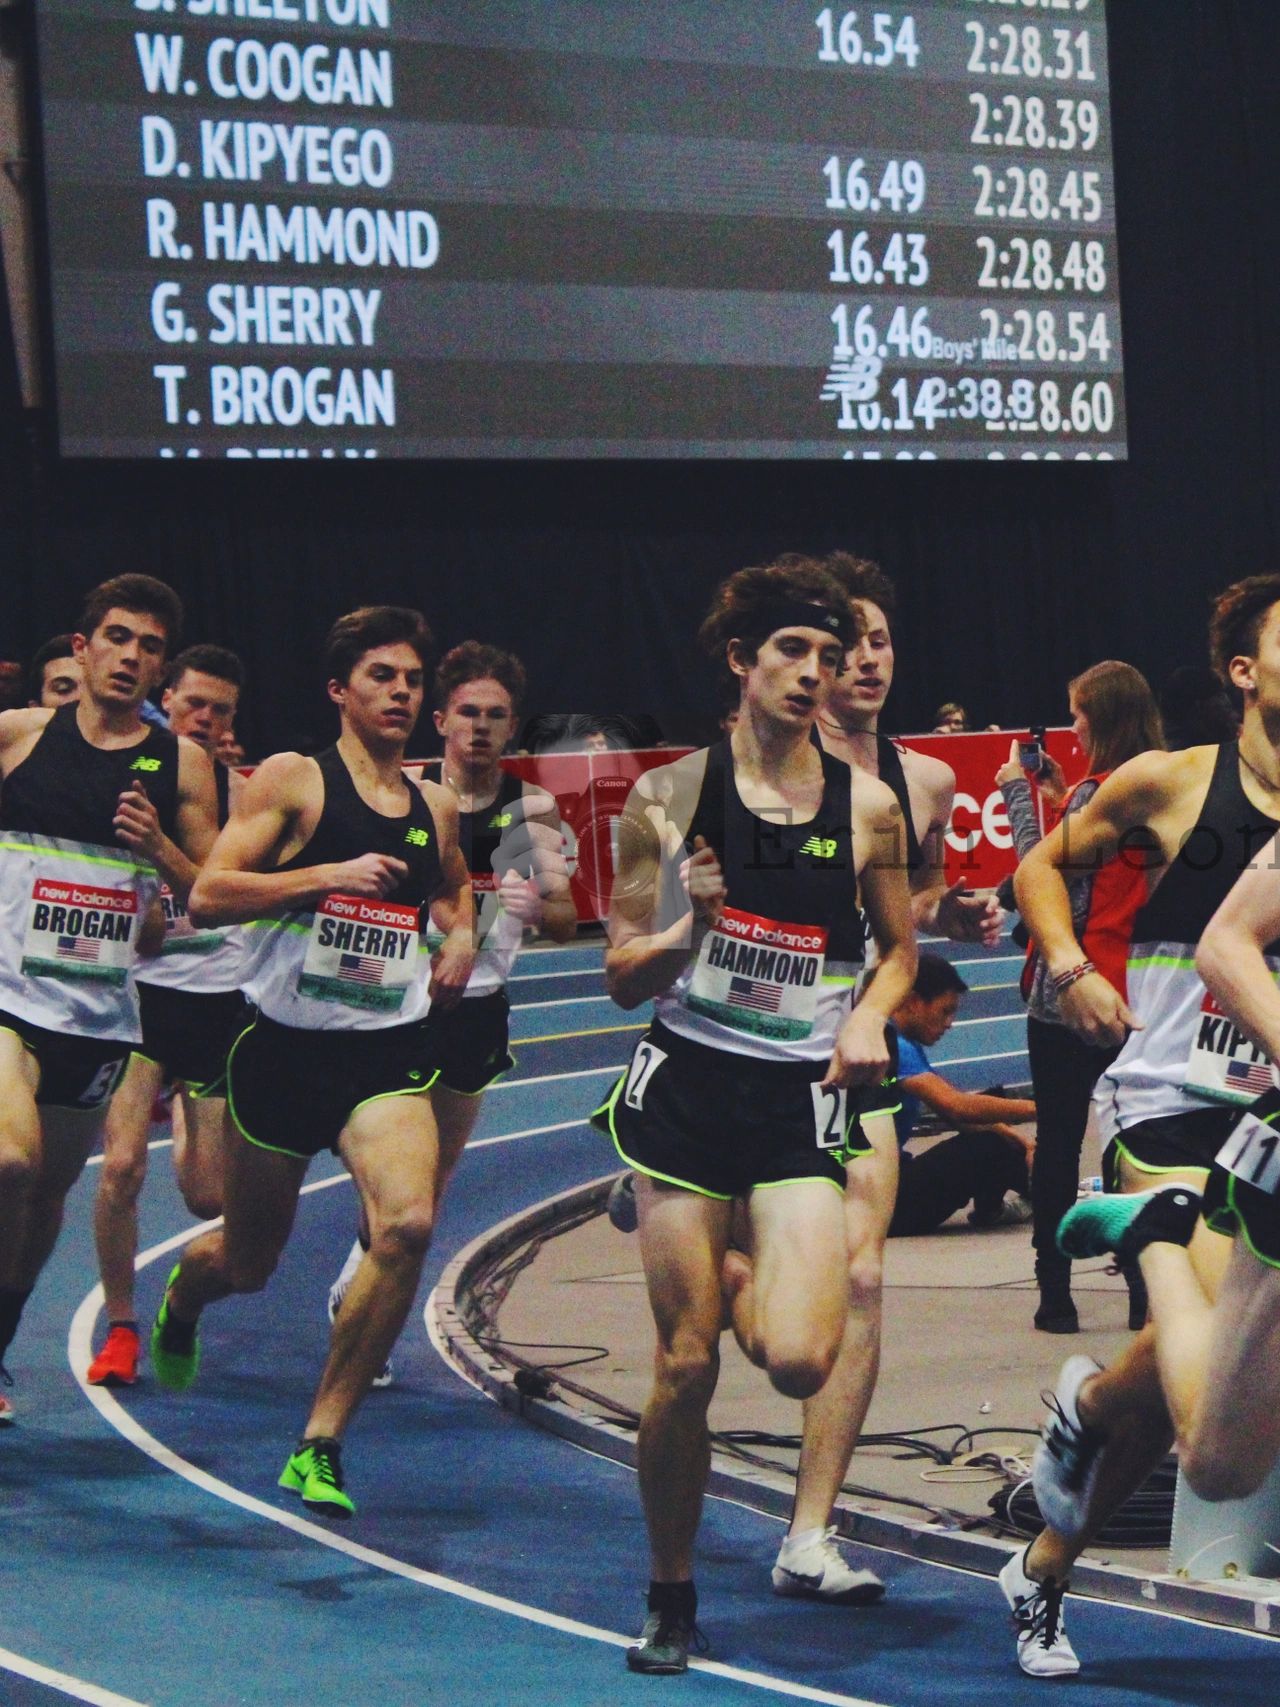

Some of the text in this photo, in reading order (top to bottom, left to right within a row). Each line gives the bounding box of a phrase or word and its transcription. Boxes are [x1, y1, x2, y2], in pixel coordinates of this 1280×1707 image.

[815, 8, 1096, 81] 16.54 2:28.31
[135, 33, 1099, 151] W. COOGAN 2:28.39
[142, 116, 1102, 222] D. KIPYEGO 16.49 2:28.45
[147, 198, 1106, 292] R. HAMMOND 16.43 2:28.48
[151, 282, 1111, 363] G. SHERRY 16.46 2:28.54
[154, 365, 200, 424] T.
[211, 365, 395, 426] BROGAN
[32, 902, 133, 943] BROGAN
[38, 885, 134, 910] new balance
[324, 899, 416, 926] new balance
[317, 917, 412, 961] SHERRY
[707, 935, 820, 987] HAMMOND
[715, 914, 824, 949] new balance
[820, 1083, 841, 1144] 2
[1231, 1125, 1280, 1184] 11
